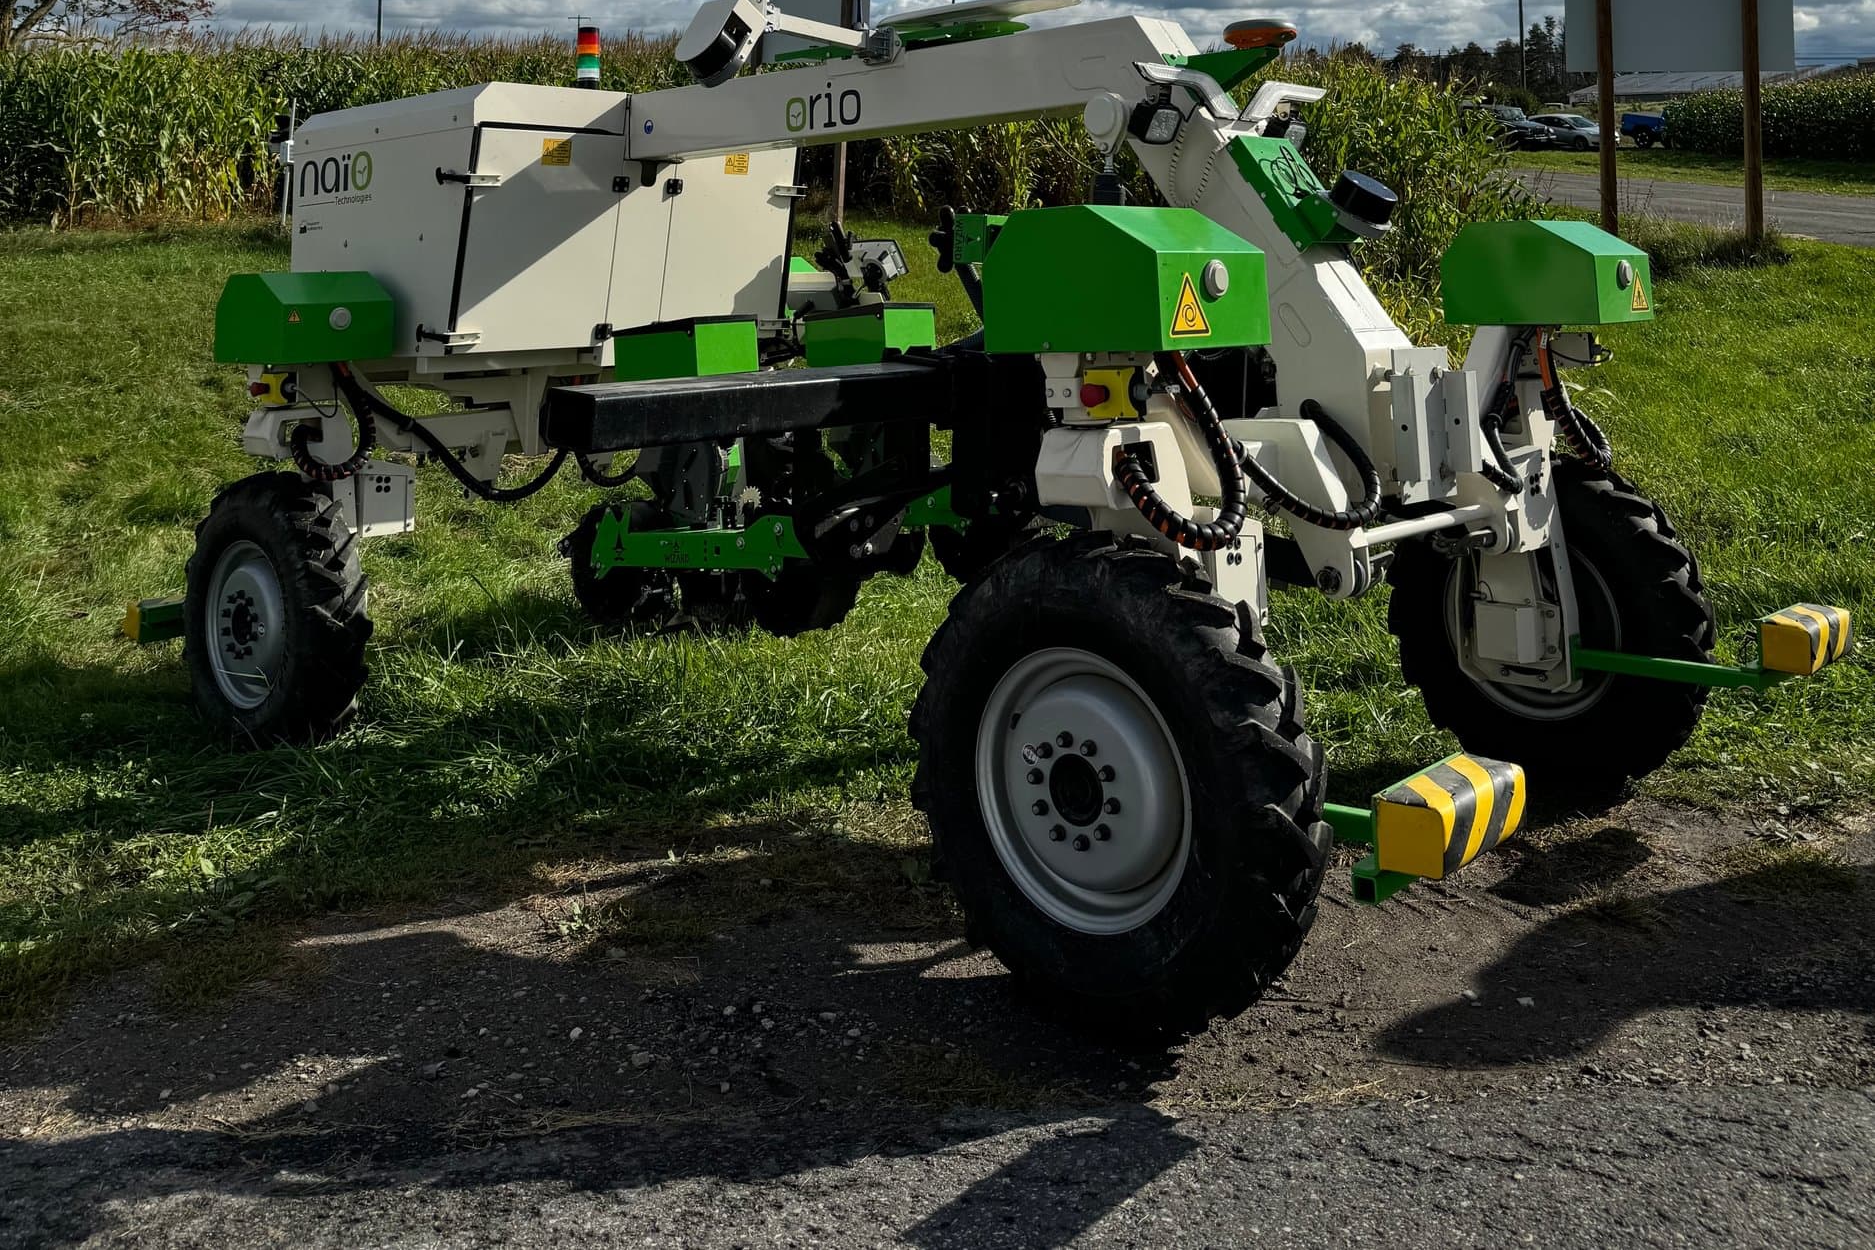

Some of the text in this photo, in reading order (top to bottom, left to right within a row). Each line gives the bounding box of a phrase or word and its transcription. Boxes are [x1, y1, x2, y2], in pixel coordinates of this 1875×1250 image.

[786, 81, 861, 132] orio
[335, 193, 372, 206] Technologies
[955, 219, 963, 261] WIZARD
